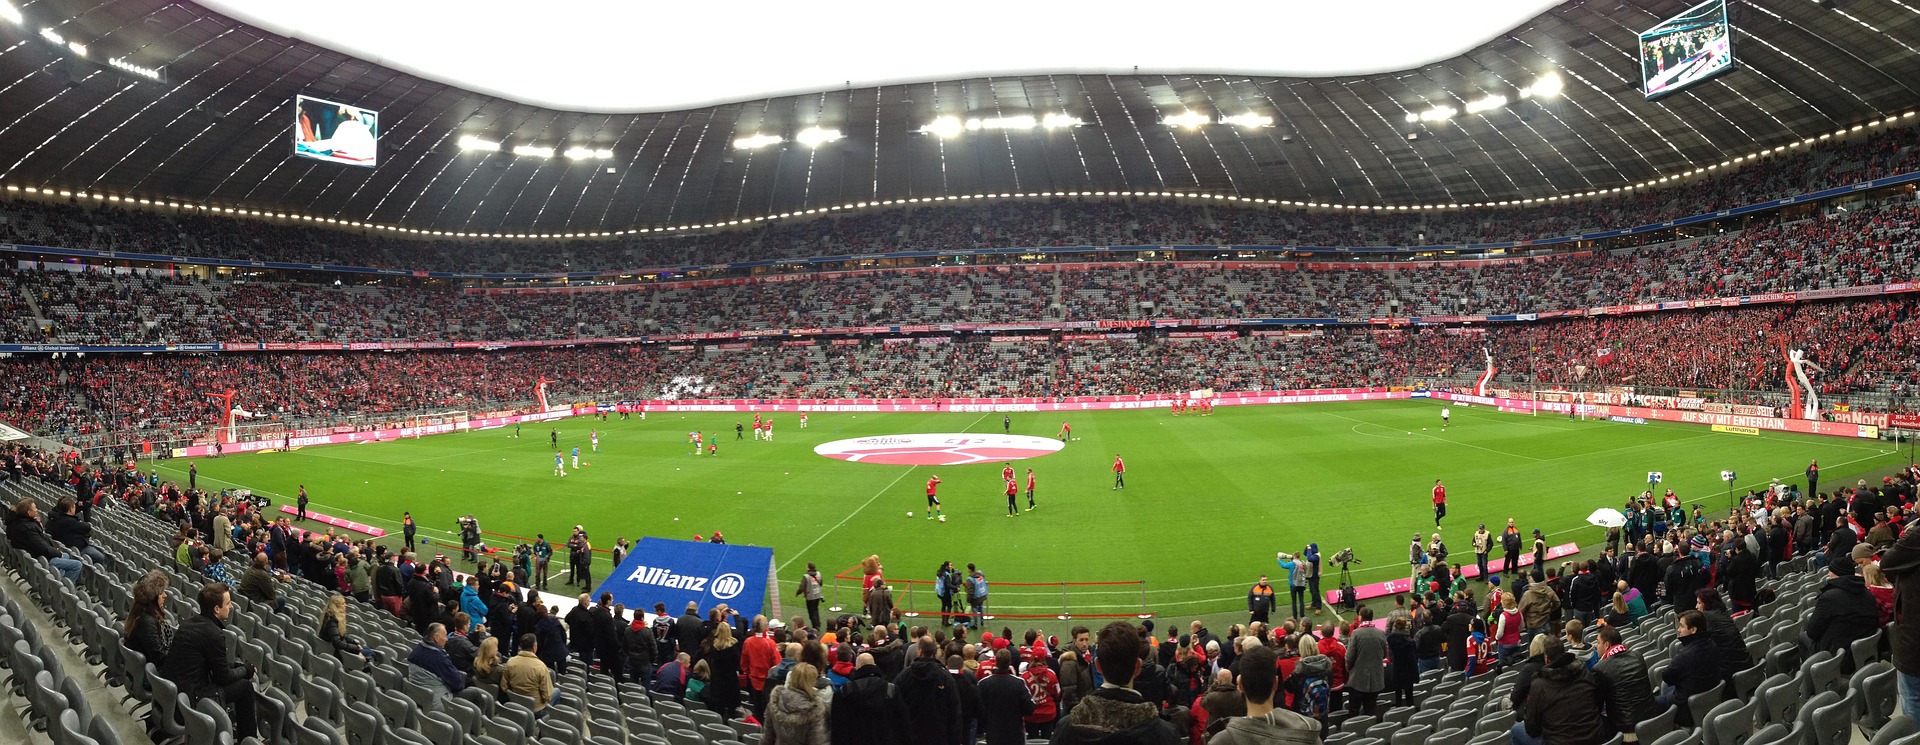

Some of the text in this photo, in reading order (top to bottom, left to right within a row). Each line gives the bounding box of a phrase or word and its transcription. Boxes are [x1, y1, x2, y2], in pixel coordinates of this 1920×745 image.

[1886, 283, 1906, 291] SANDER
[1682, 413, 1698, 421] AUF
[1699, 414, 1715, 423] SKY
[1717, 416, 1732, 425] MIT
[1852, 412, 1887, 429] Nord
[1725, 426, 1757, 434] Lufthansa
[240, 442, 256, 451] AUF
[257, 440, 273, 449] SKY
[626, 565, 709, 592] Allianz
[1477, 642, 1488, 658] 19
[1031, 683, 1048, 701] 25
